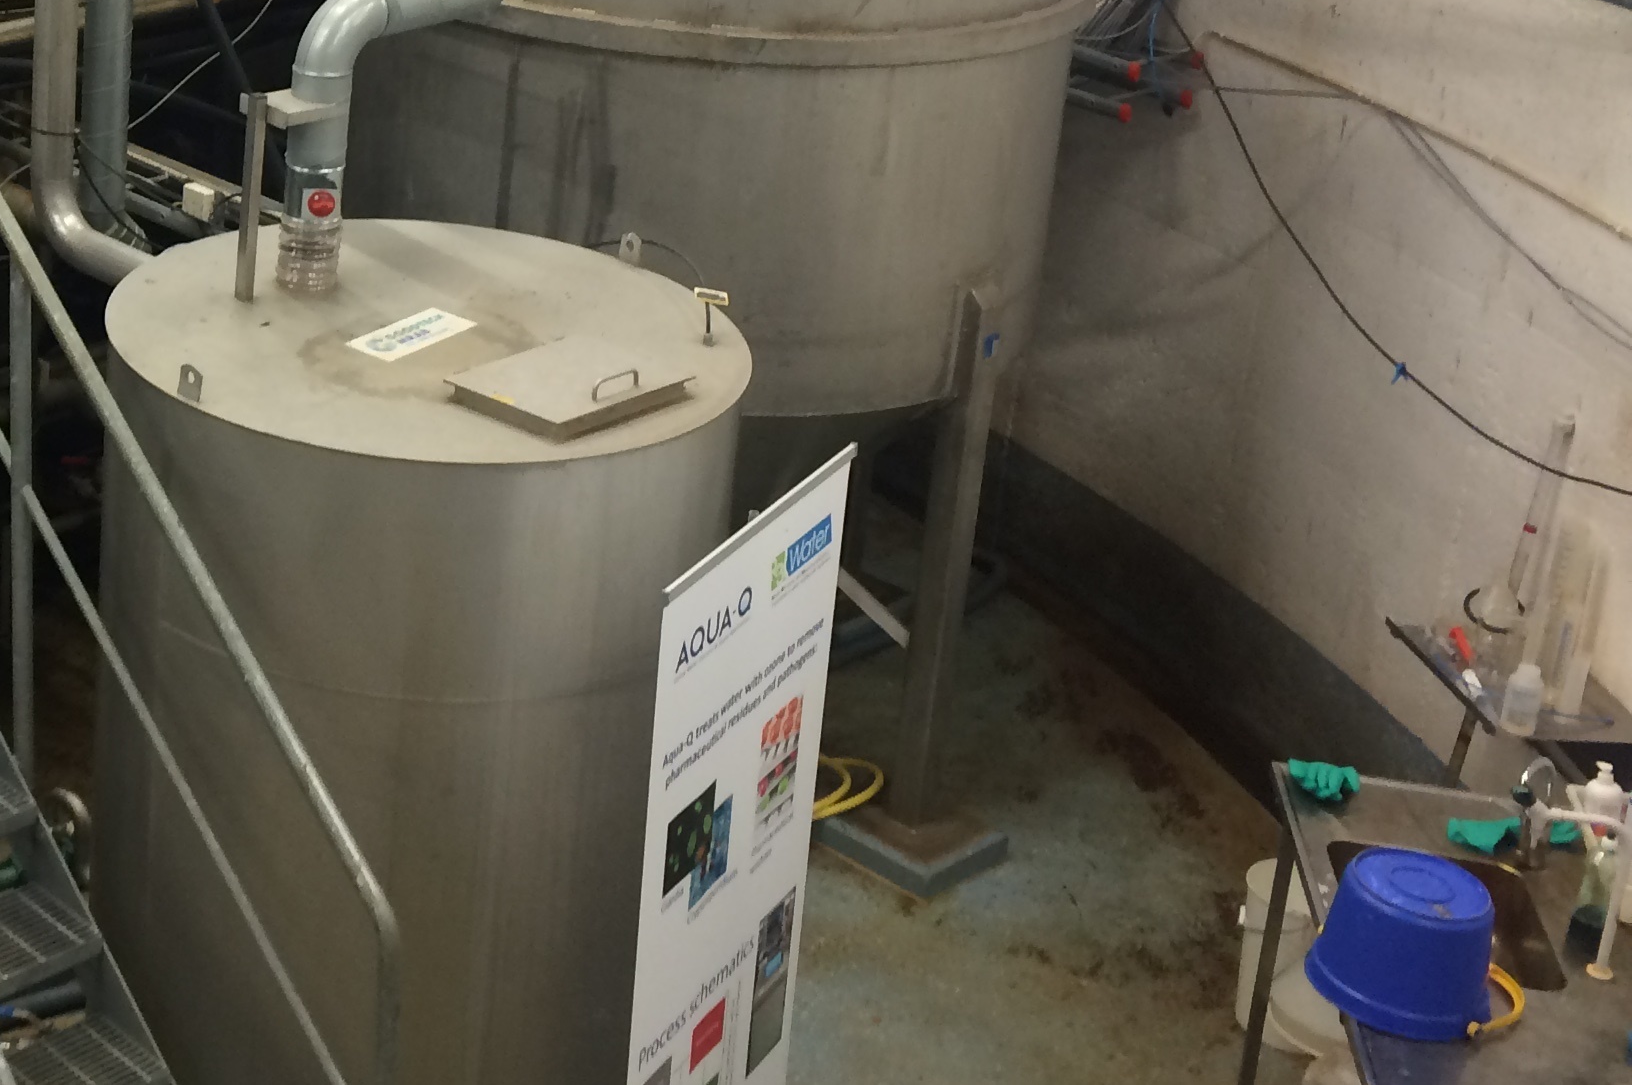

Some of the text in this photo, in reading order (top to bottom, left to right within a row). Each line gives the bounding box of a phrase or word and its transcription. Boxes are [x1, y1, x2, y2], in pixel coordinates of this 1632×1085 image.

[662, 731, 694, 770] Aqua-Q
[695, 711, 720, 740] treats
[720, 687, 744, 716] water
[744, 671, 763, 695] with
[787, 643, 796, 658] to
[796, 617, 825, 648] remove
[675, 586, 753, 674] AQUA-Q
[665, 722, 727, 792] pharmaceutical
[727, 694, 762, 731] residues
[762, 675, 777, 701] and
[638, 1010, 687, 1073] Process
[689, 934, 755, 1018] schematics
